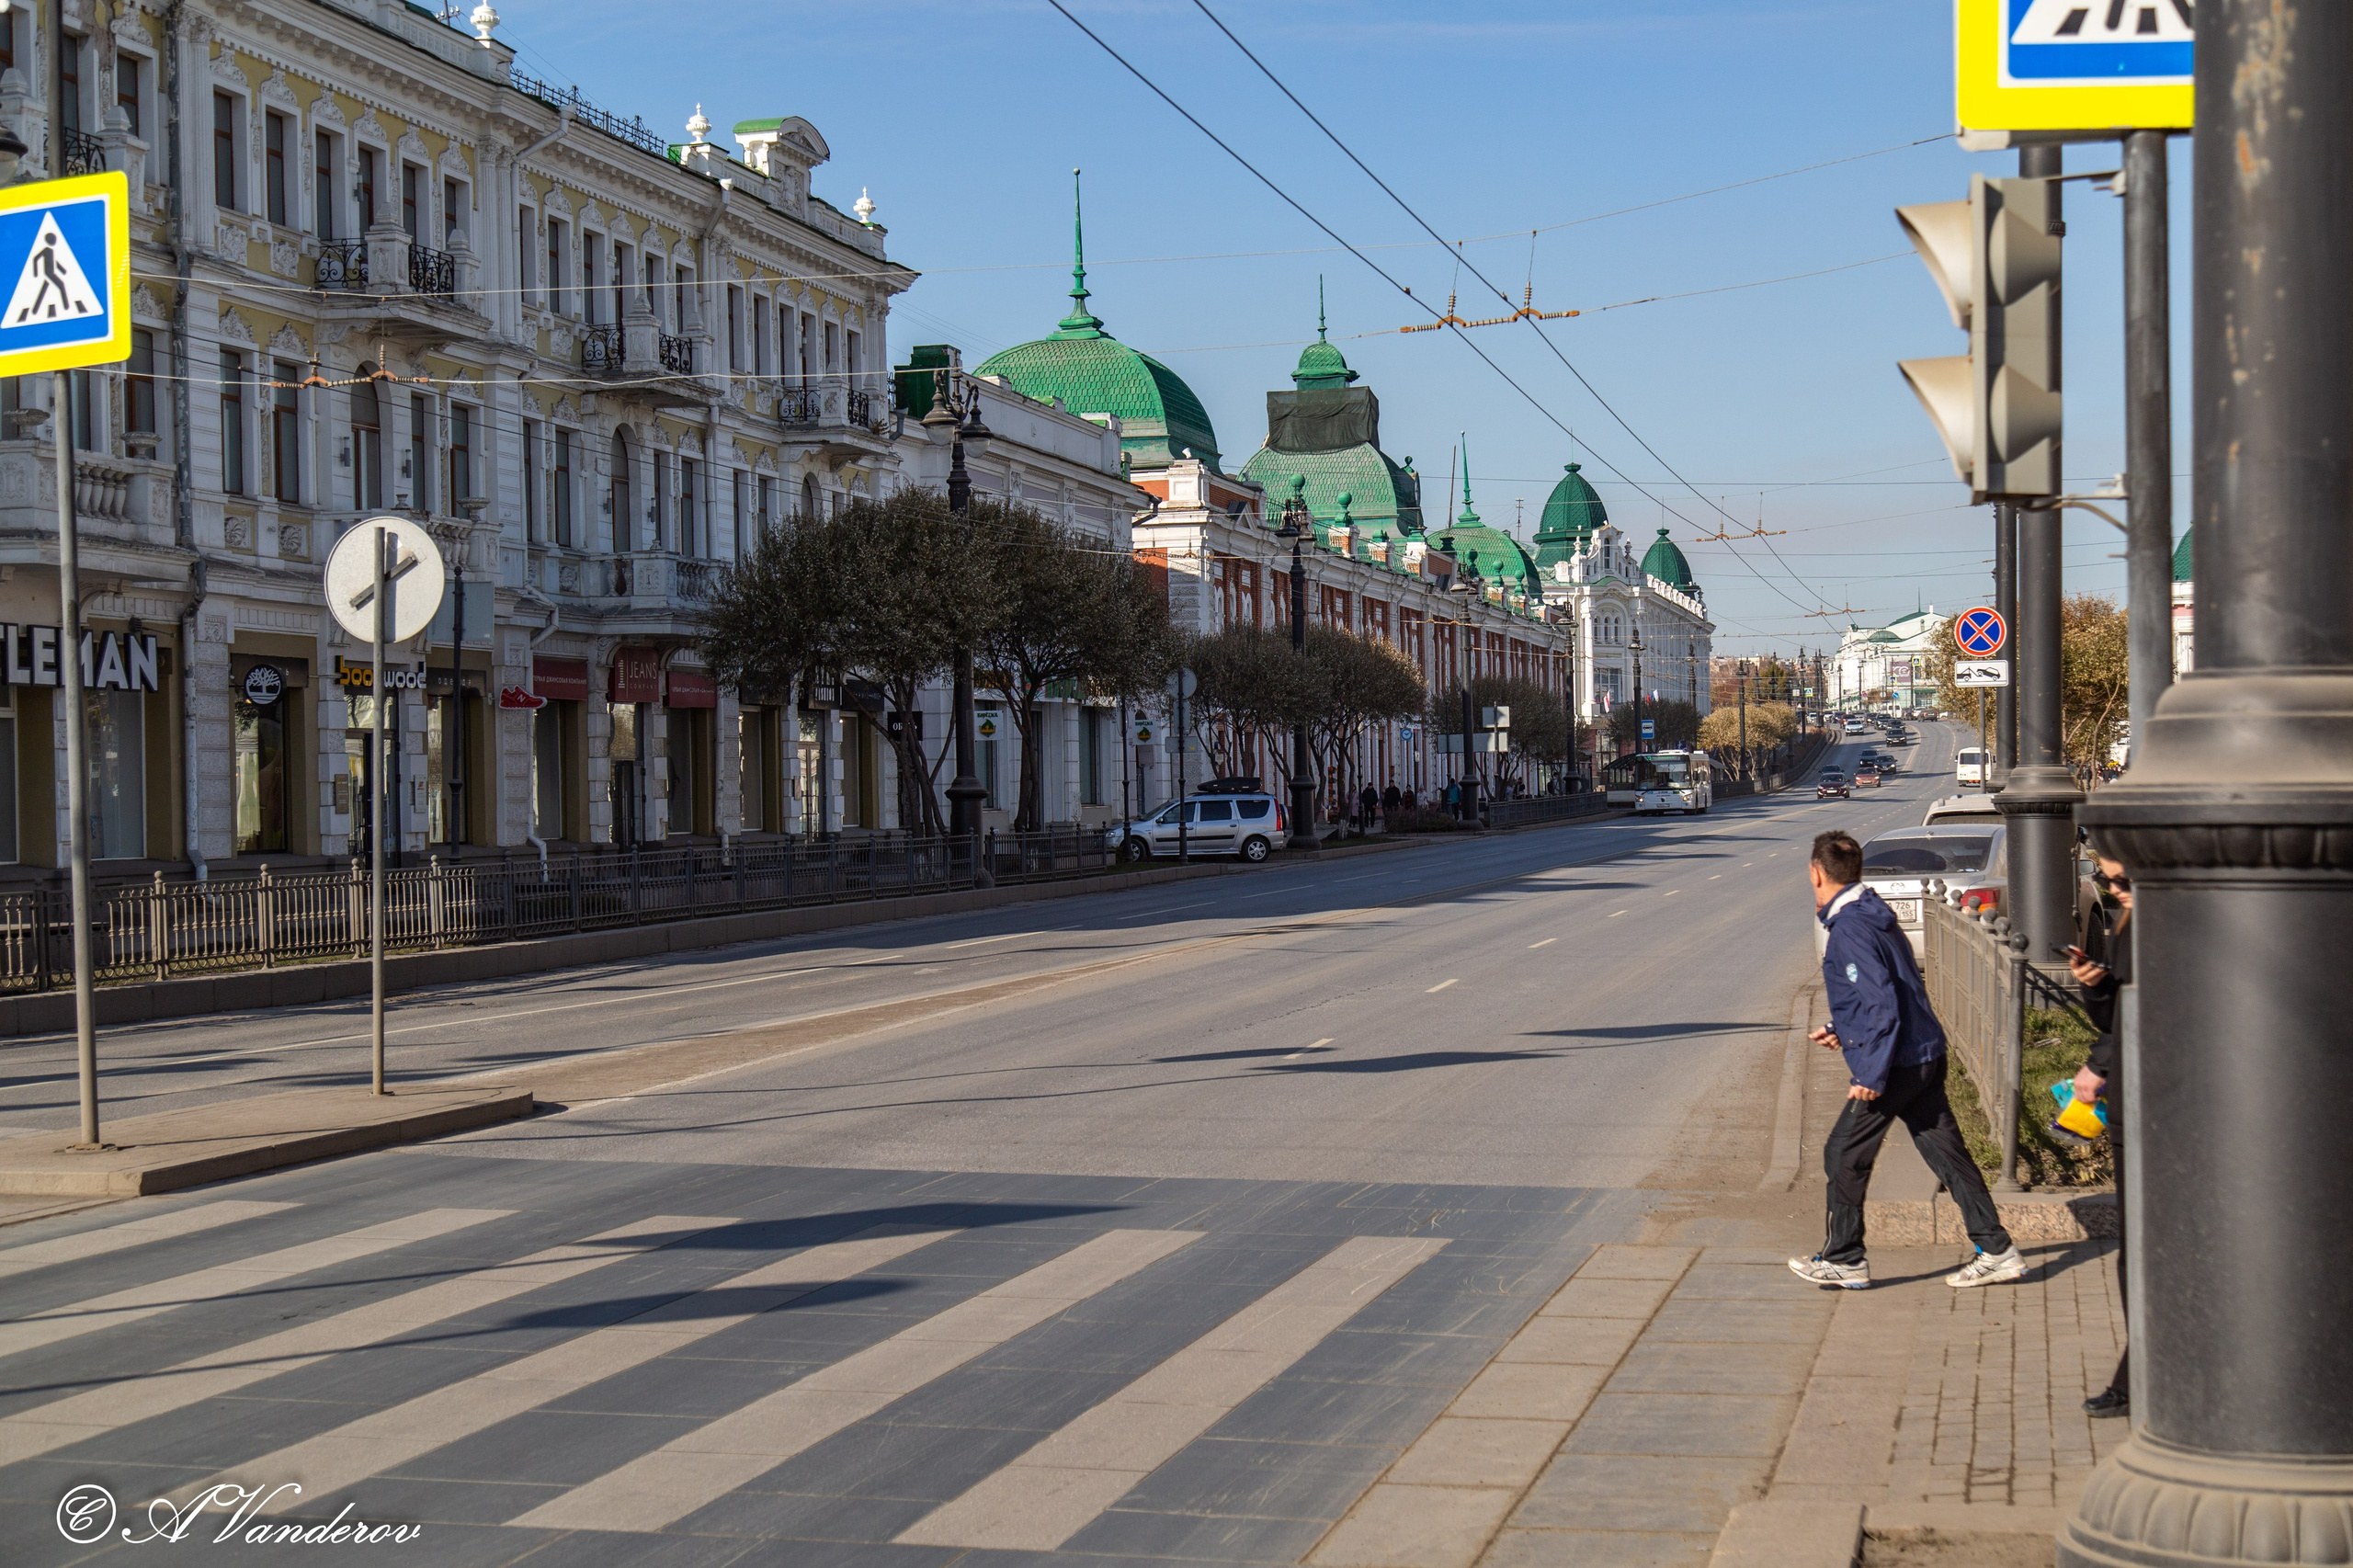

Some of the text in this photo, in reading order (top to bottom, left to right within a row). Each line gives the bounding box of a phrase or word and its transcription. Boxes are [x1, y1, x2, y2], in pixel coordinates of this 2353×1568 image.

[337, 655, 426, 688] boowood
[630, 662, 657, 679] JEANS
[438, 676, 472, 687] одеда
